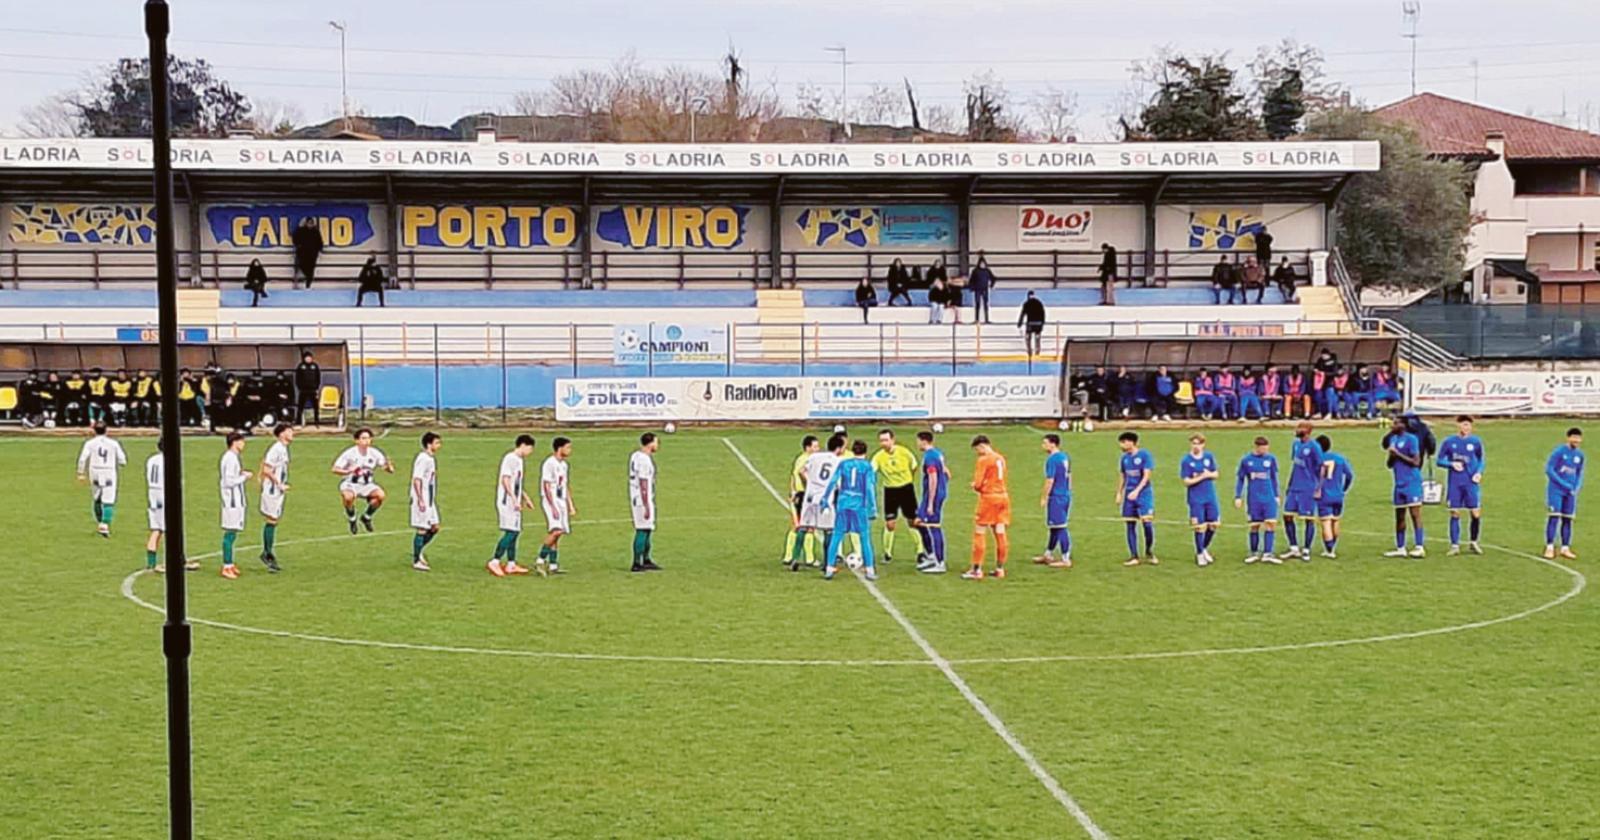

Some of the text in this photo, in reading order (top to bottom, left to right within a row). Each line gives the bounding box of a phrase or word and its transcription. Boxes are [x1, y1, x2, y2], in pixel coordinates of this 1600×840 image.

[403, 206, 577, 248] PORTO
[620, 206, 740, 248] VIRO
[587, 391, 666, 407] EDILFERRO
[724, 383, 798, 401] RadioDiva
[97, 447, 108, 463] 4
[818, 462, 832, 481] 6
[850, 465, 857, 488] 1
